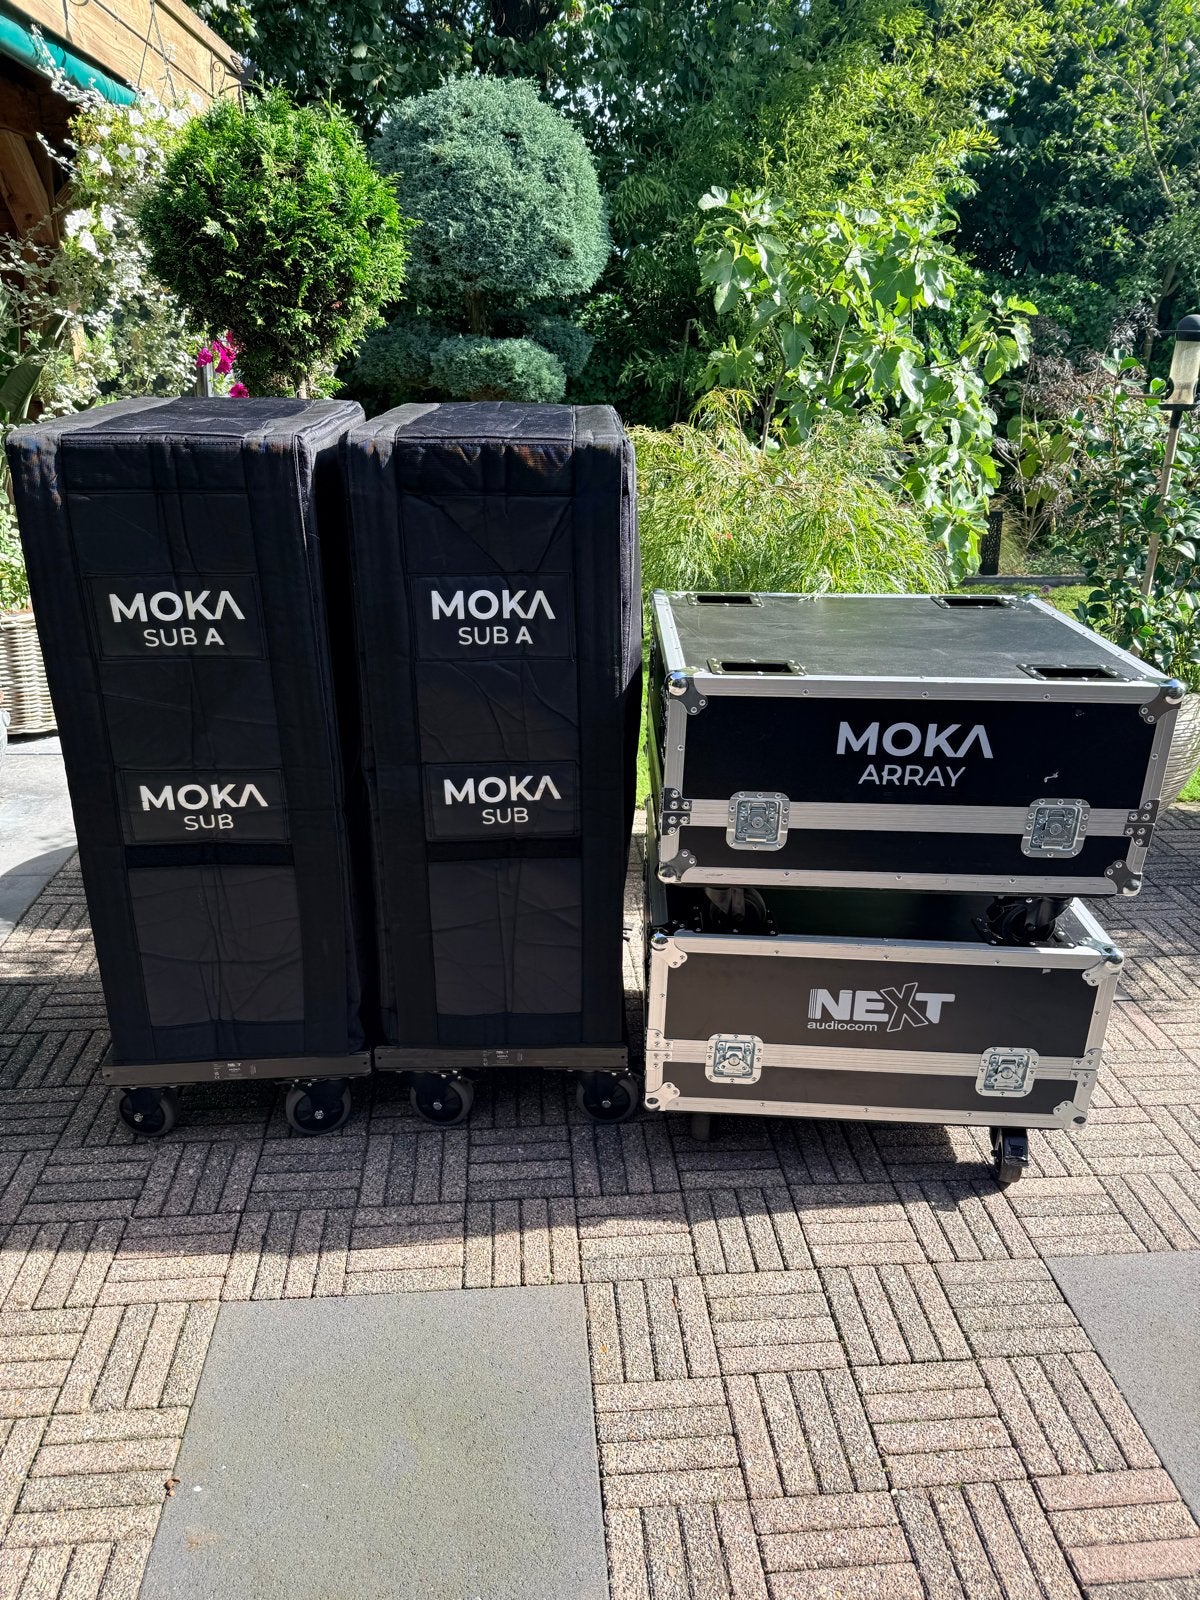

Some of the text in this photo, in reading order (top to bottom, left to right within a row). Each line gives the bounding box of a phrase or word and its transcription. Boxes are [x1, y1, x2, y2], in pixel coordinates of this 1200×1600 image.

[143, 627, 225, 647] SUB A
[458, 626, 534, 645] SUB A
[858, 764, 966, 787] ARRAY
[183, 813, 234, 831] SUB
[482, 807, 529, 825] SUB
[808, 982, 956, 1033] NEXT
[807, 1020, 878, 1032] audiocom
